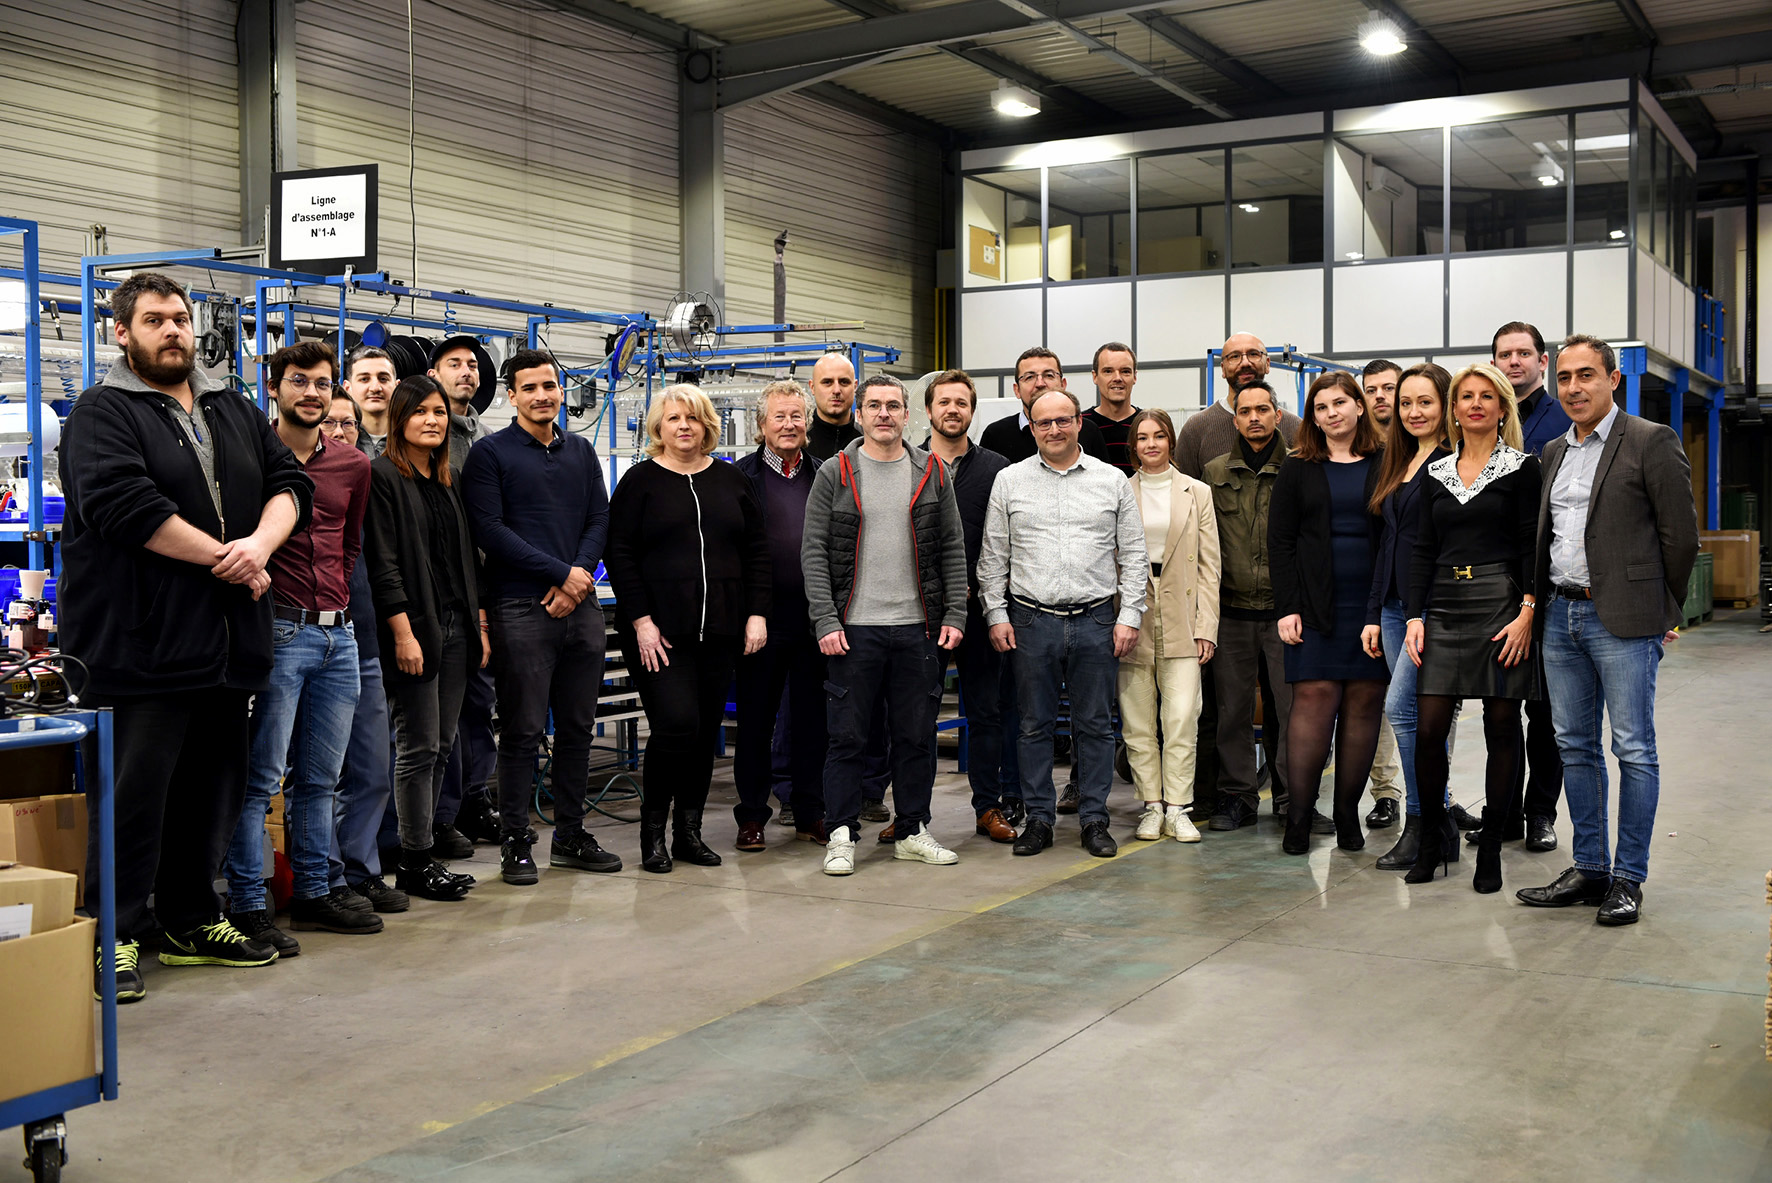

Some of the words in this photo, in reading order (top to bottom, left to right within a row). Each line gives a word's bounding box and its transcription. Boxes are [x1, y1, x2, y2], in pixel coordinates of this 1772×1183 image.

[311, 195, 336, 207] Ligne
[291, 211, 355, 222] d'assemblage
[40, 680, 64, 688] CAPA
